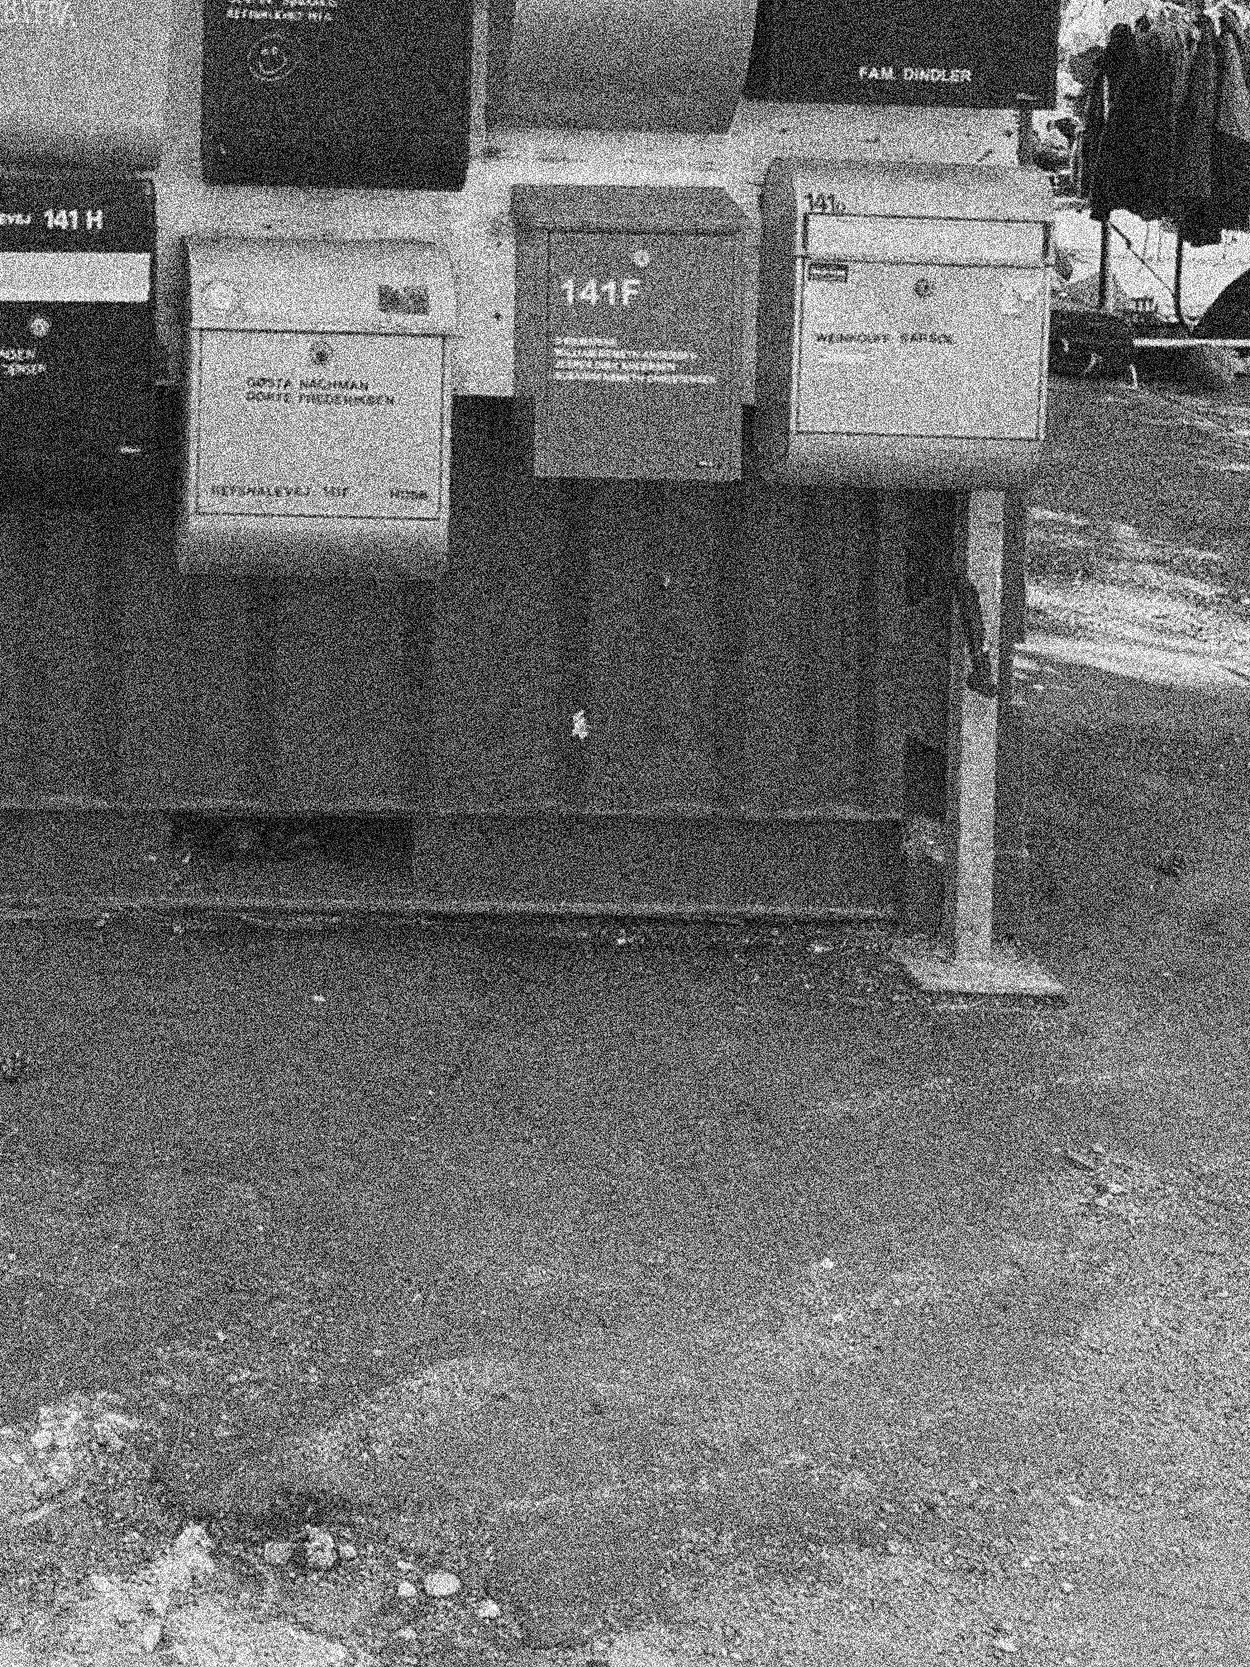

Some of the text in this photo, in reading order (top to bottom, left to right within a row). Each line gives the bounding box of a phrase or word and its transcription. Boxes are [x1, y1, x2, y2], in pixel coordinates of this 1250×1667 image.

[902, 68, 972, 84] DINDLER
[44, 209, 78, 230] 141
[561, 278, 640, 306] 141F
[298, 393, 395, 408] FREDERIKSEN
